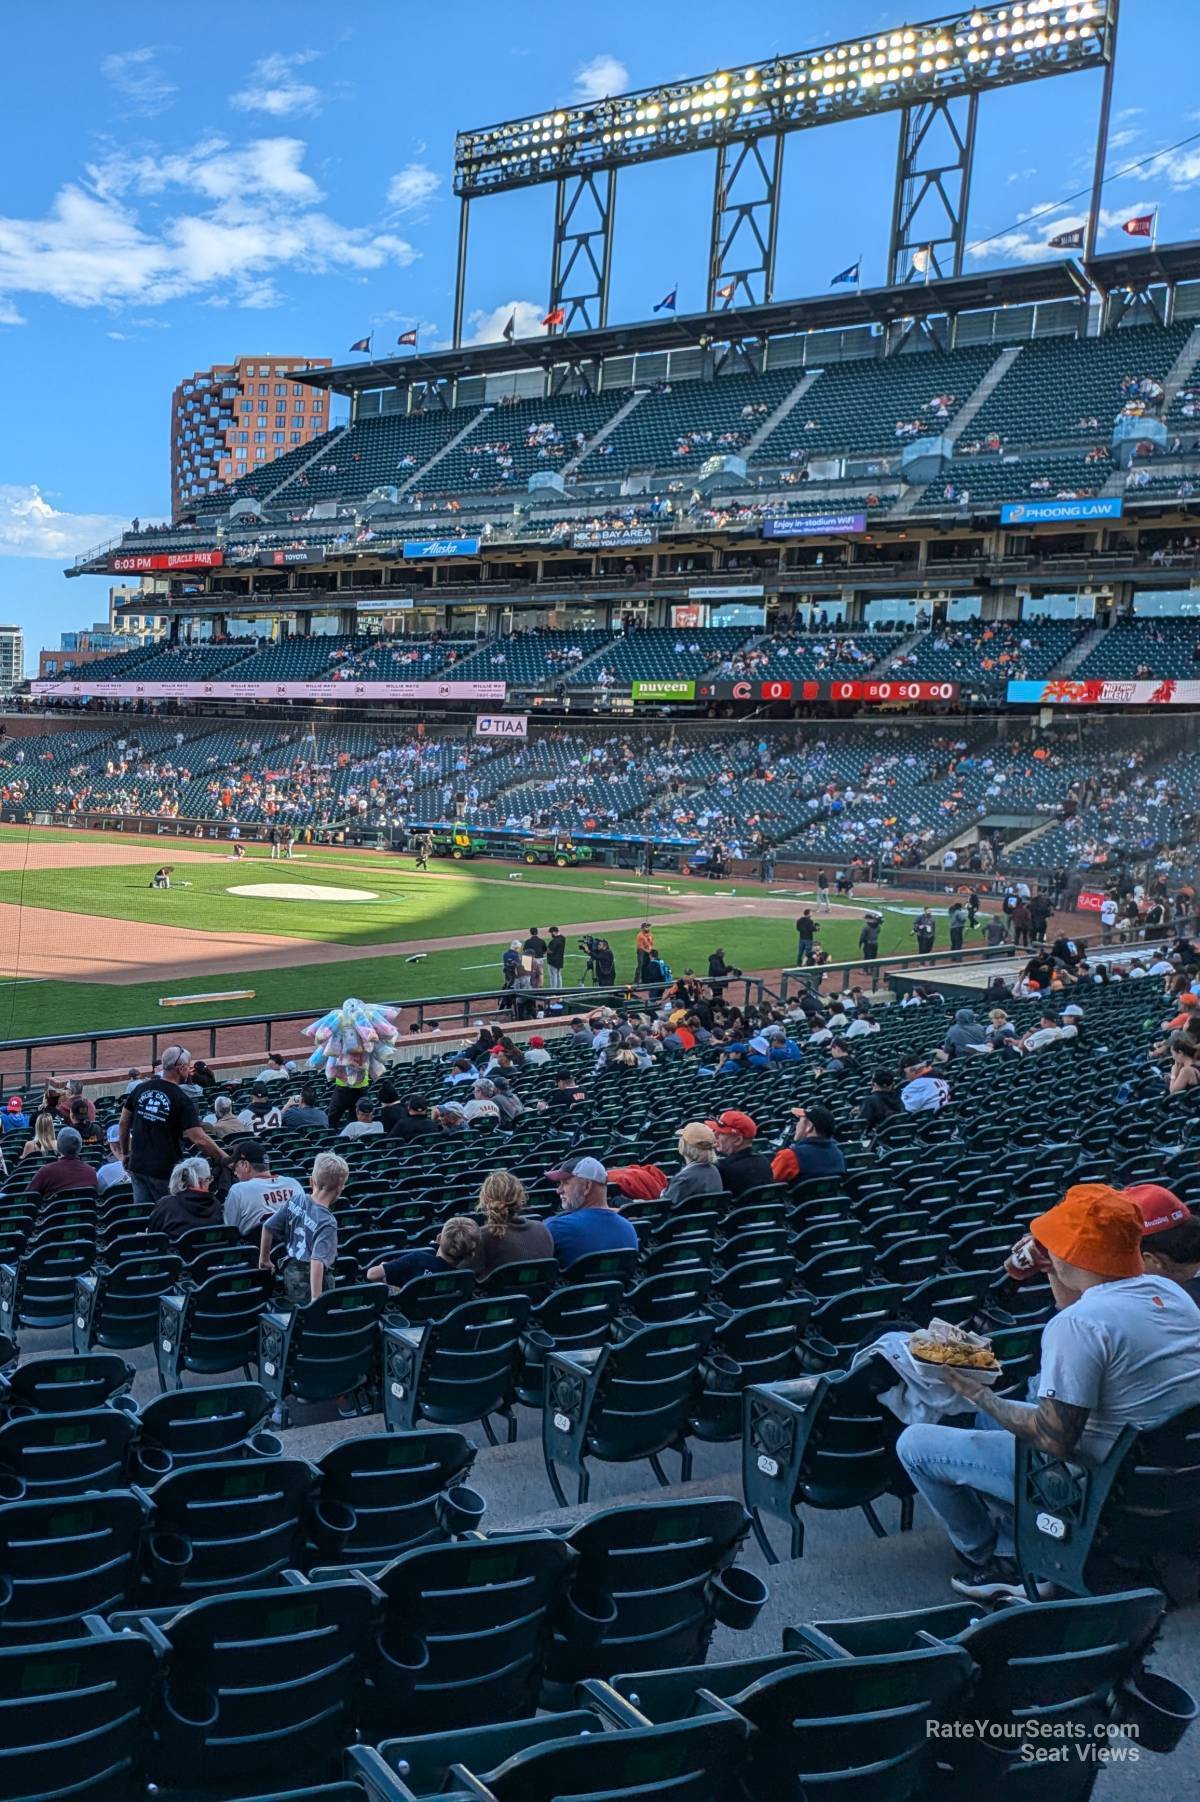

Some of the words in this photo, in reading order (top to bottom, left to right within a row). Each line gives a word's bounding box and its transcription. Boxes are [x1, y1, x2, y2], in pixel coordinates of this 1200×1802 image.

[1027, 506, 1080, 518] PHOONG
[1083, 504, 1112, 516] LAW
[774, 520, 793, 530] Enjoy
[795, 518, 836, 527] in-stadium
[574, 533, 591, 541] NBC
[603, 530, 622, 539] BAY
[623, 529, 651, 538] AREA
[616, 537, 651, 546] FORWARD
[422, 542, 457, 555] Alaska
[114, 559, 135, 569] 6:03
[137, 558, 151, 568] PM
[168, 555, 193, 567] ORACLE
[195, 552, 212, 564] PARK
[639, 682, 688, 693] nuveen
[709, 684, 715, 696] 1
[771, 684, 782, 697] 0
[841, 684, 853, 697] 0
[1102, 683, 1136, 693] NOTHING
[1102, 690, 1121, 700] LIKE
[1121, 690, 1133, 700] IT
[493, 720, 524, 733] TIAA
[251, 1112, 280, 1132] 24
[263, 1189, 294, 1206] POSEY
[556, 1415, 568, 1428] 24
[761, 1460, 775, 1472] 25
[1042, 1516, 1059, 1533] 26
